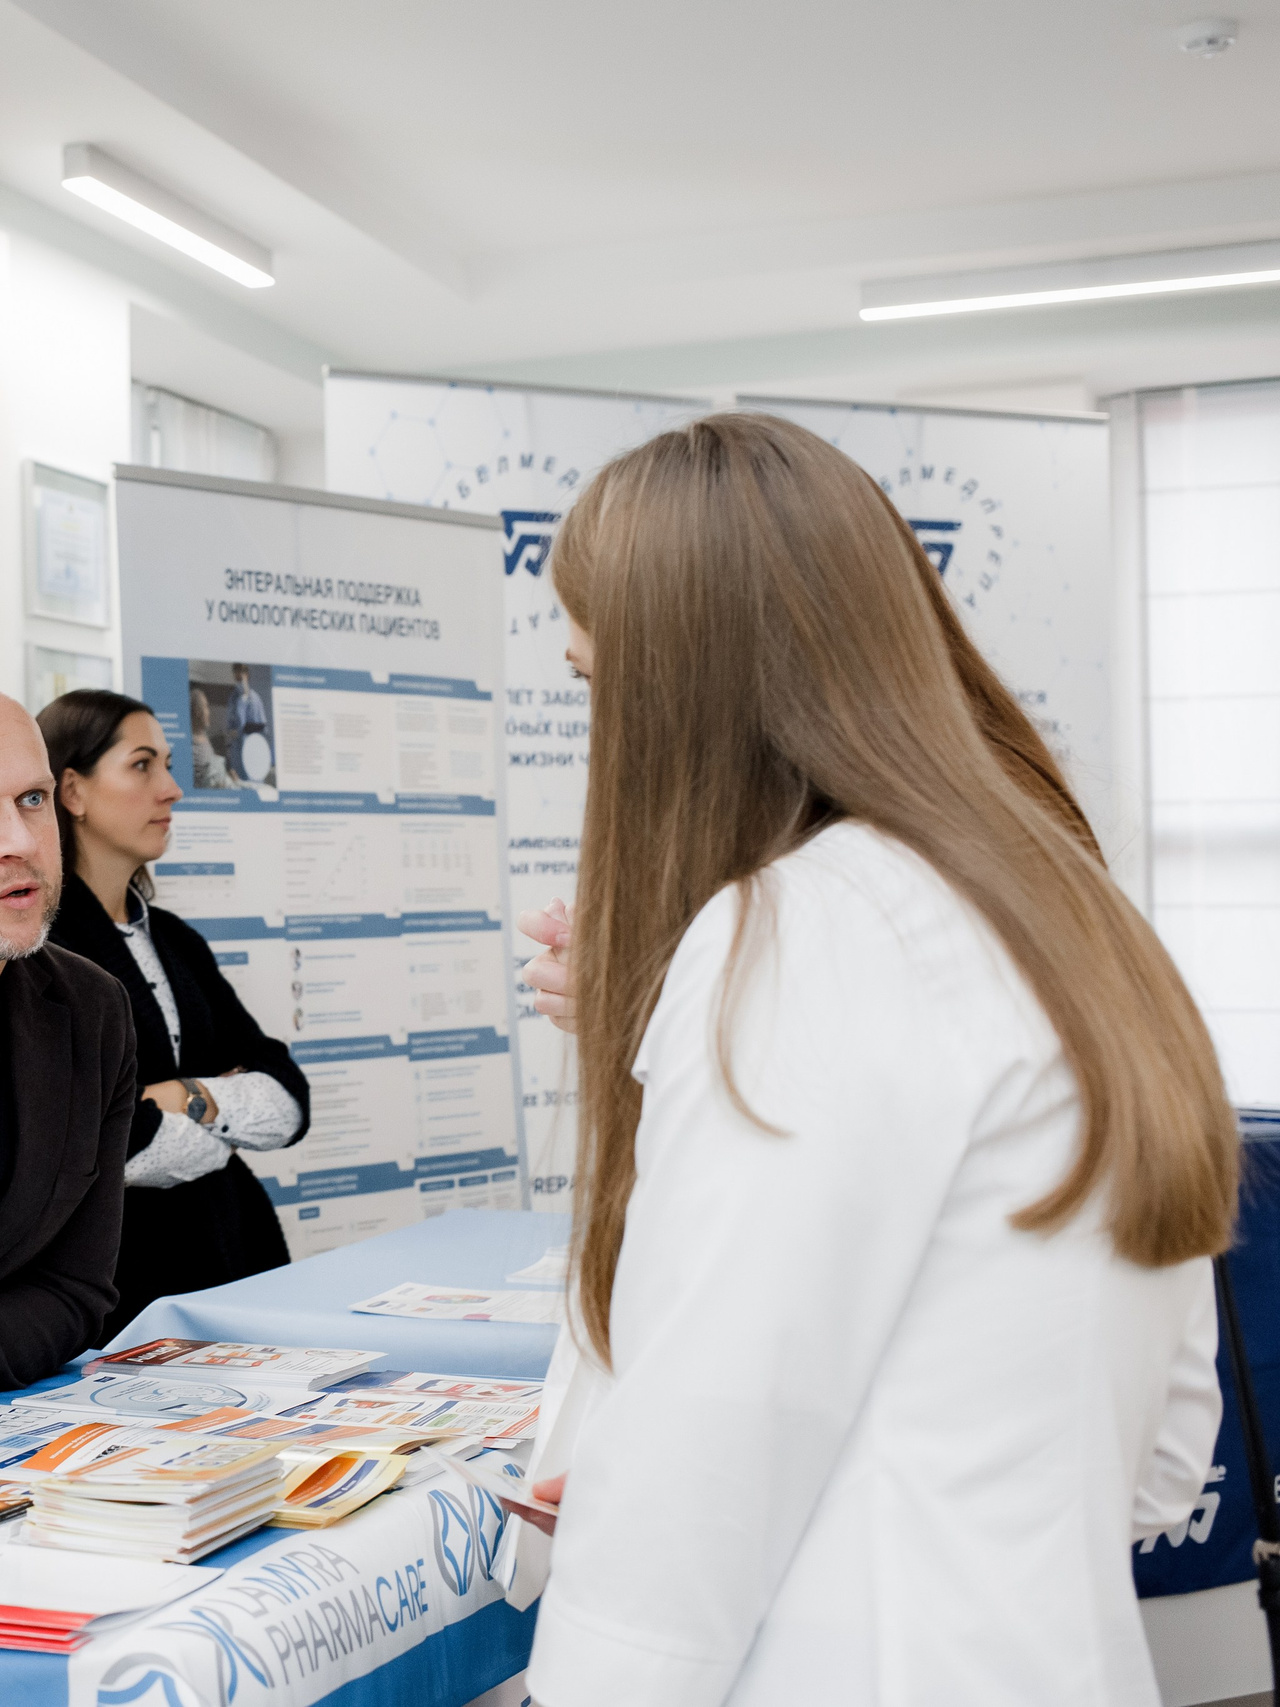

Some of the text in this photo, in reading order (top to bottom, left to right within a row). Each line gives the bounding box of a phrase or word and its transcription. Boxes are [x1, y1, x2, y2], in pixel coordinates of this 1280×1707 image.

[224, 568, 422, 607] ЭНТЕРАЛЬНАЯ ПОДДЕРЖКА
[205, 599, 441, 641] У ОНКОЛОГИЧЕСКИХ ПАЦИЕНТОВ
[541, 689, 588, 706] ЗАБО
[534, 860, 577, 875] ПРЕПА
[227, 1543, 360, 1618] LAMYRA
[264, 1558, 429, 1688] PHARMACARE
